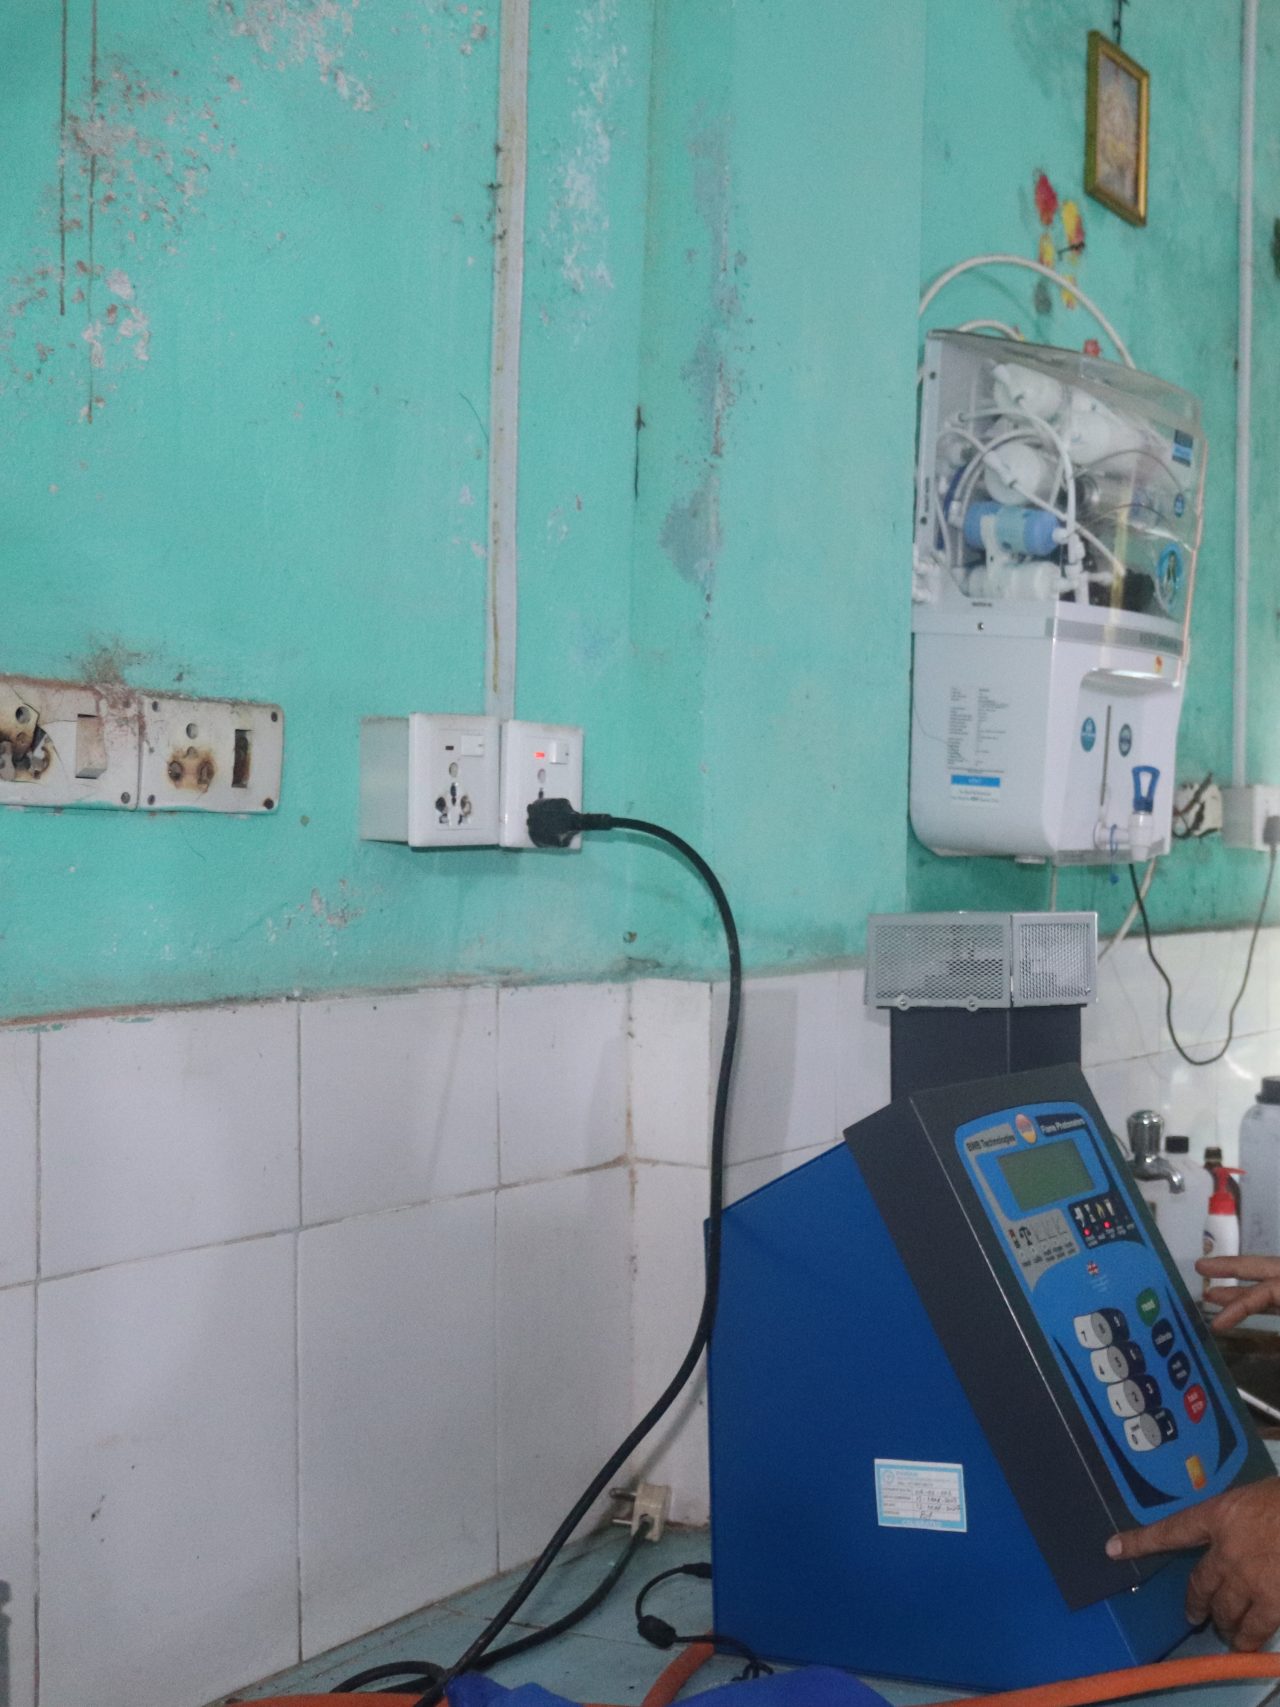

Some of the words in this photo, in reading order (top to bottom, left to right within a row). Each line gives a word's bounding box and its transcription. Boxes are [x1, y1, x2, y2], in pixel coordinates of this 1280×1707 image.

[980, 1133, 1016, 1149] Technologies
[1080, 1330, 1088, 1342] 7
[1098, 1363, 1106, 1376] 4
[1114, 1356, 1123, 1369] 5
[1114, 1399, 1123, 1412] 1
[1131, 1391, 1140, 1403] 2
[1145, 1382, 1154, 1395] 3
[1130, 1433, 1139, 1446] 0
